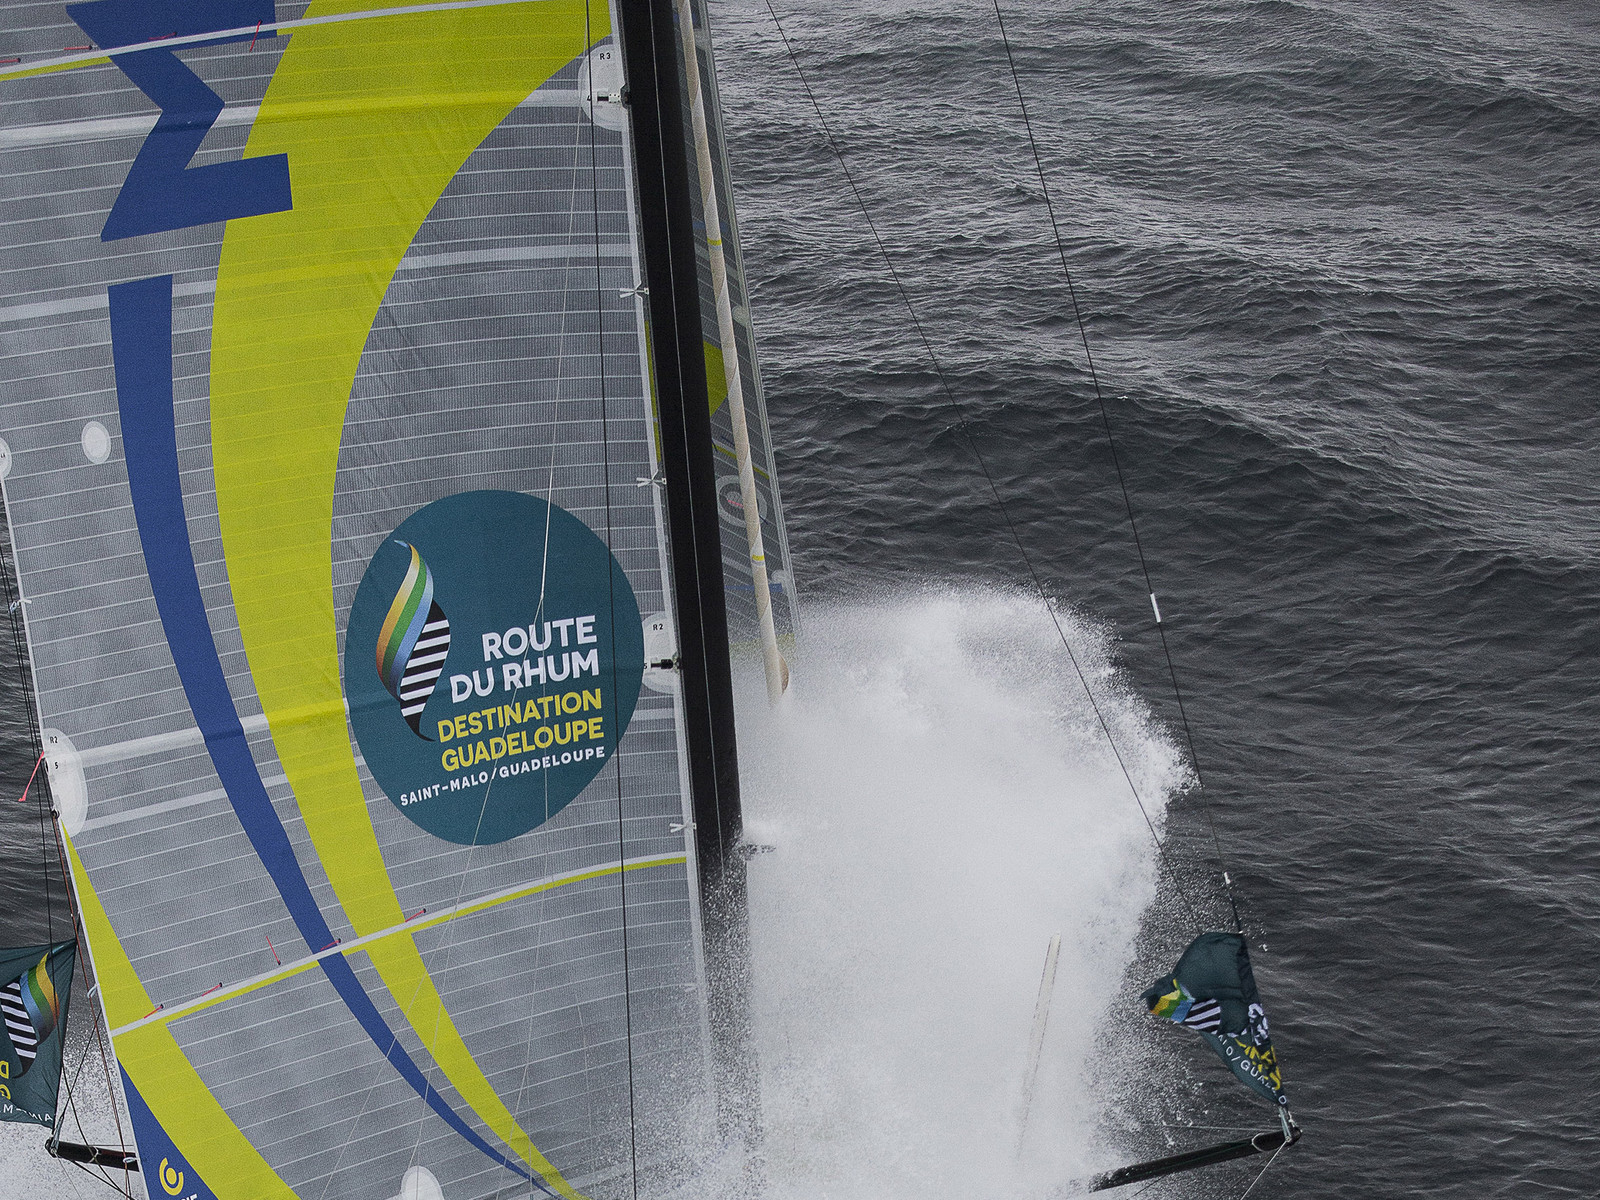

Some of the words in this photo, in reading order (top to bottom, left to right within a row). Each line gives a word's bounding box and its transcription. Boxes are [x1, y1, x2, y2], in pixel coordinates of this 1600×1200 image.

[482, 615, 598, 662] ROUTE
[451, 666, 496, 703] DU
[503, 649, 600, 692] RHUM
[437, 688, 602, 743] DESTINATION
[441, 716, 605, 772] GUADELOUPE
